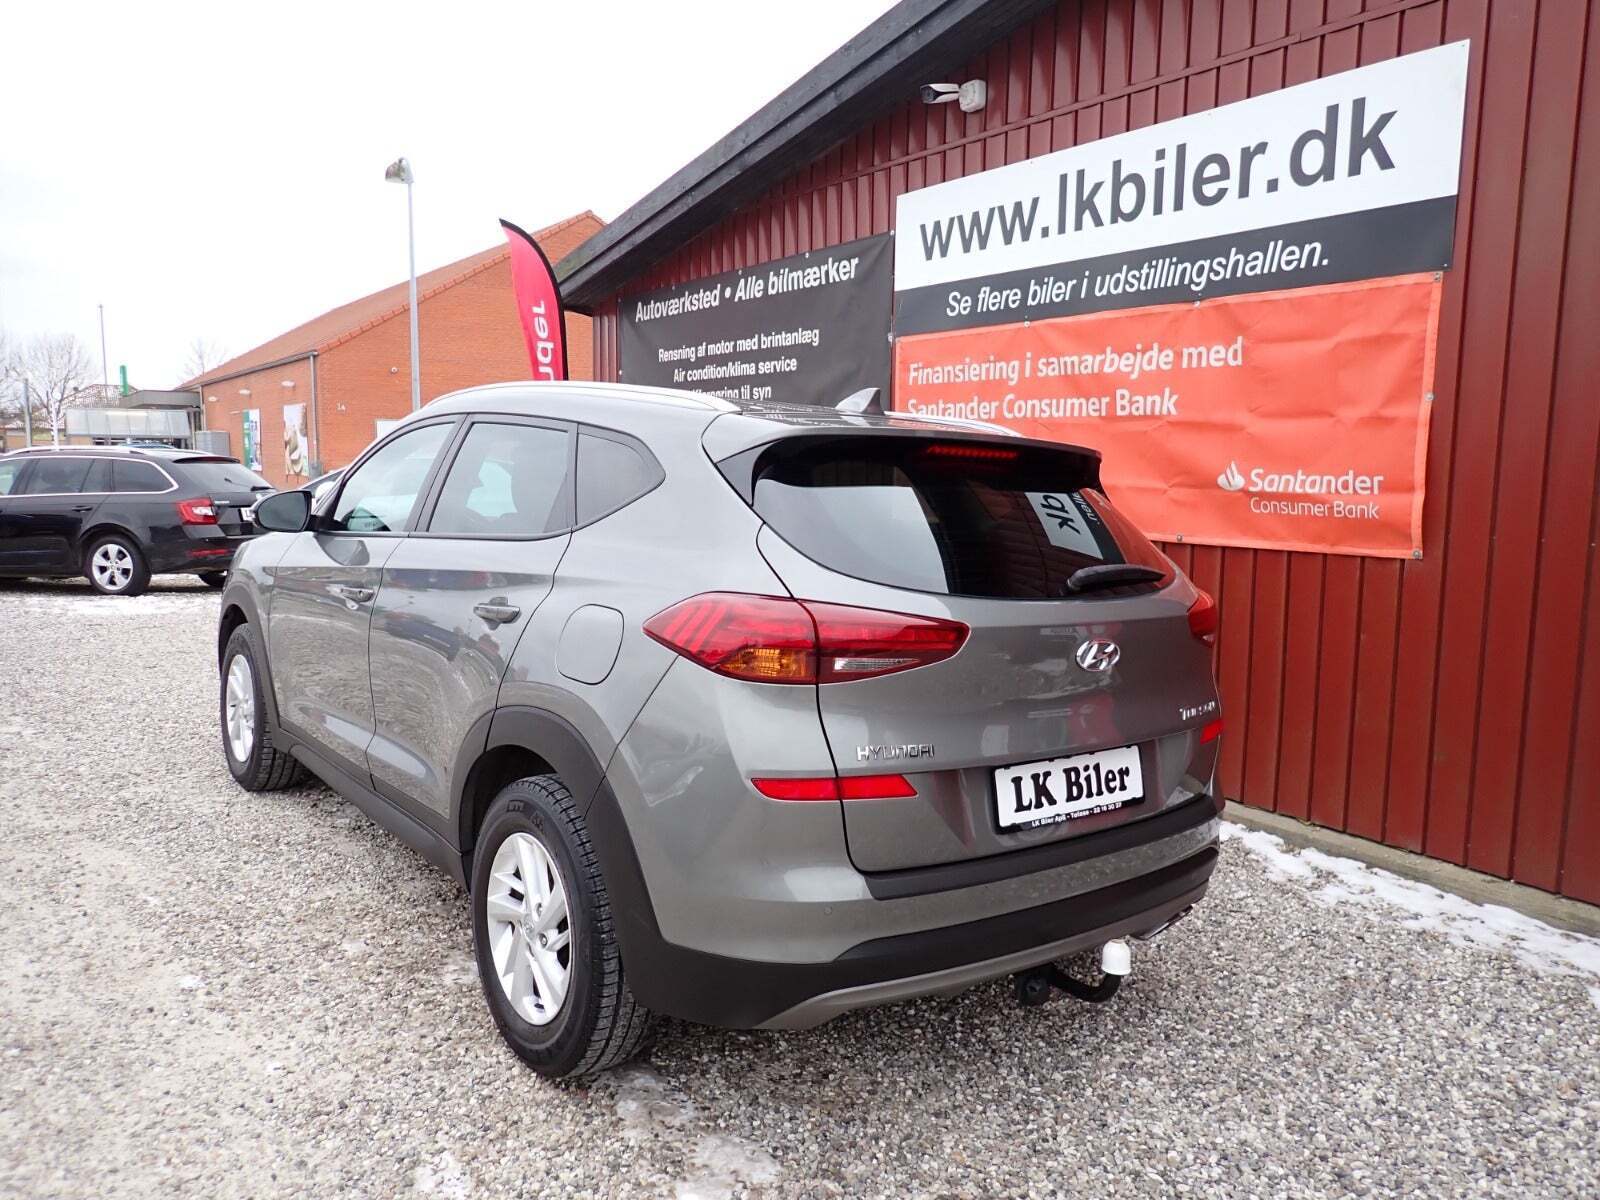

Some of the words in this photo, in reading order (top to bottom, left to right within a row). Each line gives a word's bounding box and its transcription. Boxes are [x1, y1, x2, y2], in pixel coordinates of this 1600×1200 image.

[919, 97, 1398, 262] www.lkbiler.dk
[635, 283, 721, 323] Autoværksted
[734, 276, 763, 302] Alle
[768, 255, 859, 293] bilmærker
[946, 292, 972, 317] Se
[977, 286, 1021, 313] flere
[1027, 275, 1077, 306] biler
[1080, 272, 1087, 298] i
[1094, 240, 1329, 297] udstillingshallen.
[658, 345, 696, 363] Rensning
[697, 342, 707, 358] af
[707, 340, 734, 357] motor
[736, 334, 758, 352] med
[760, 328, 819, 348] brintanlæg
[908, 357, 1019, 386] Finansiering
[1025, 353, 1031, 378] i
[1037, 342, 1173, 380] samarbejde
[1181, 336, 1243, 369] med
[673, 369, 686, 383] Air
[687, 359, 756, 382] condition/klima
[758, 357, 797, 374] service
[741, 384, 750, 400] til
[753, 385, 772, 401] syn
[907, 396, 999, 419] Santander
[1002, 392, 1113, 419] Consumer
[1116, 388, 1178, 417] Bank
[1249, 468, 1384, 496] Santander
[1250, 497, 1329, 517] Consumer
[1334, 500, 1379, 519] Bank
[856, 744, 935, 761] HYUNDAI
[1010, 772, 1057, 814] LK
[1062, 762, 1130, 803] Biler
[1031, 820, 1040, 828] LK
